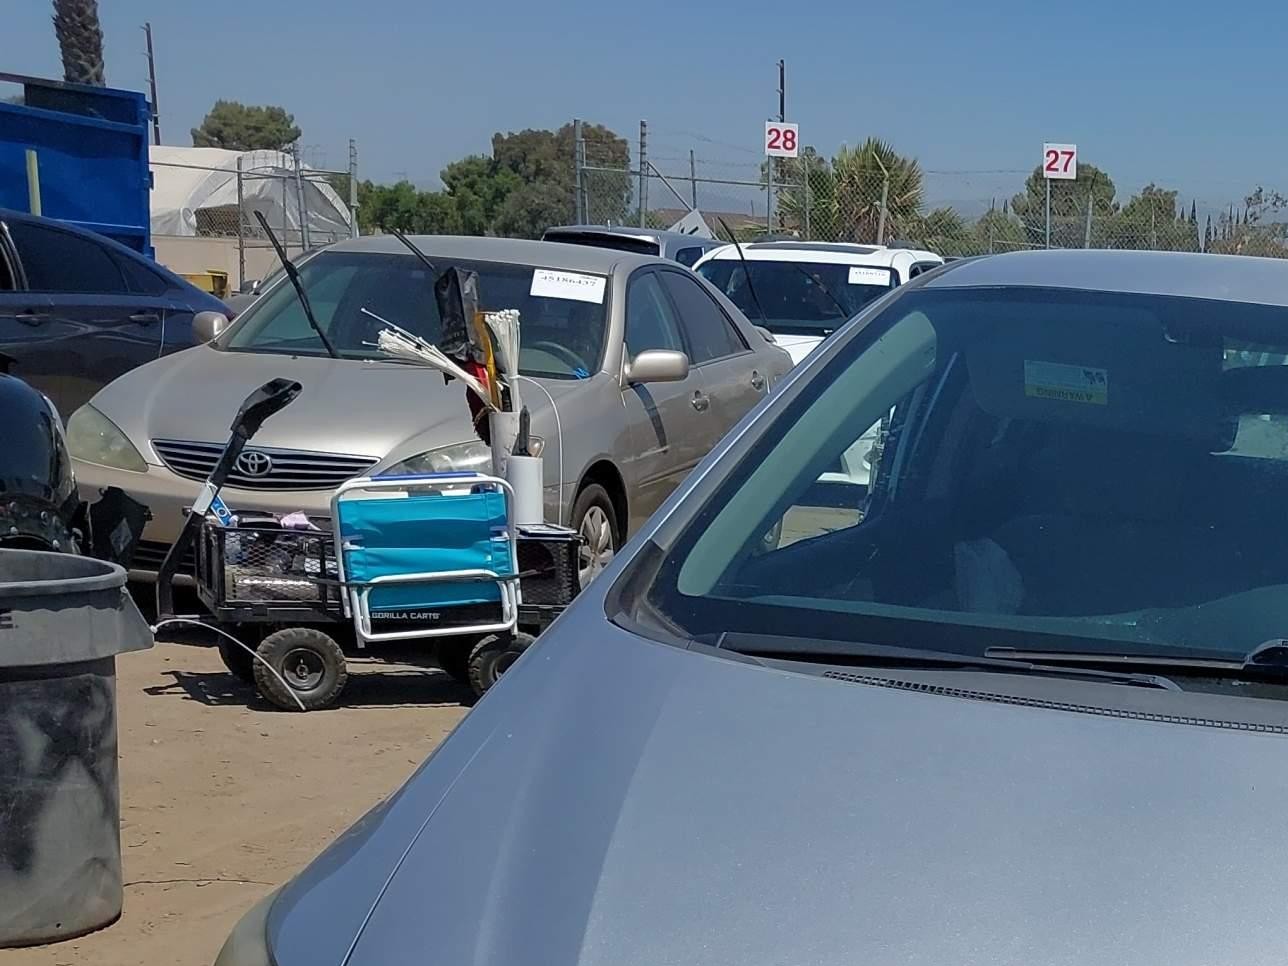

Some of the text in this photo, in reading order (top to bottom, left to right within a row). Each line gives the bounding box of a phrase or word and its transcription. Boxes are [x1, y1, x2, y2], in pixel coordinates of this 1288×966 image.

[767, 128, 796, 151] 28
[1045, 149, 1075, 173] 27
[409, 612, 440, 620] CARTS
